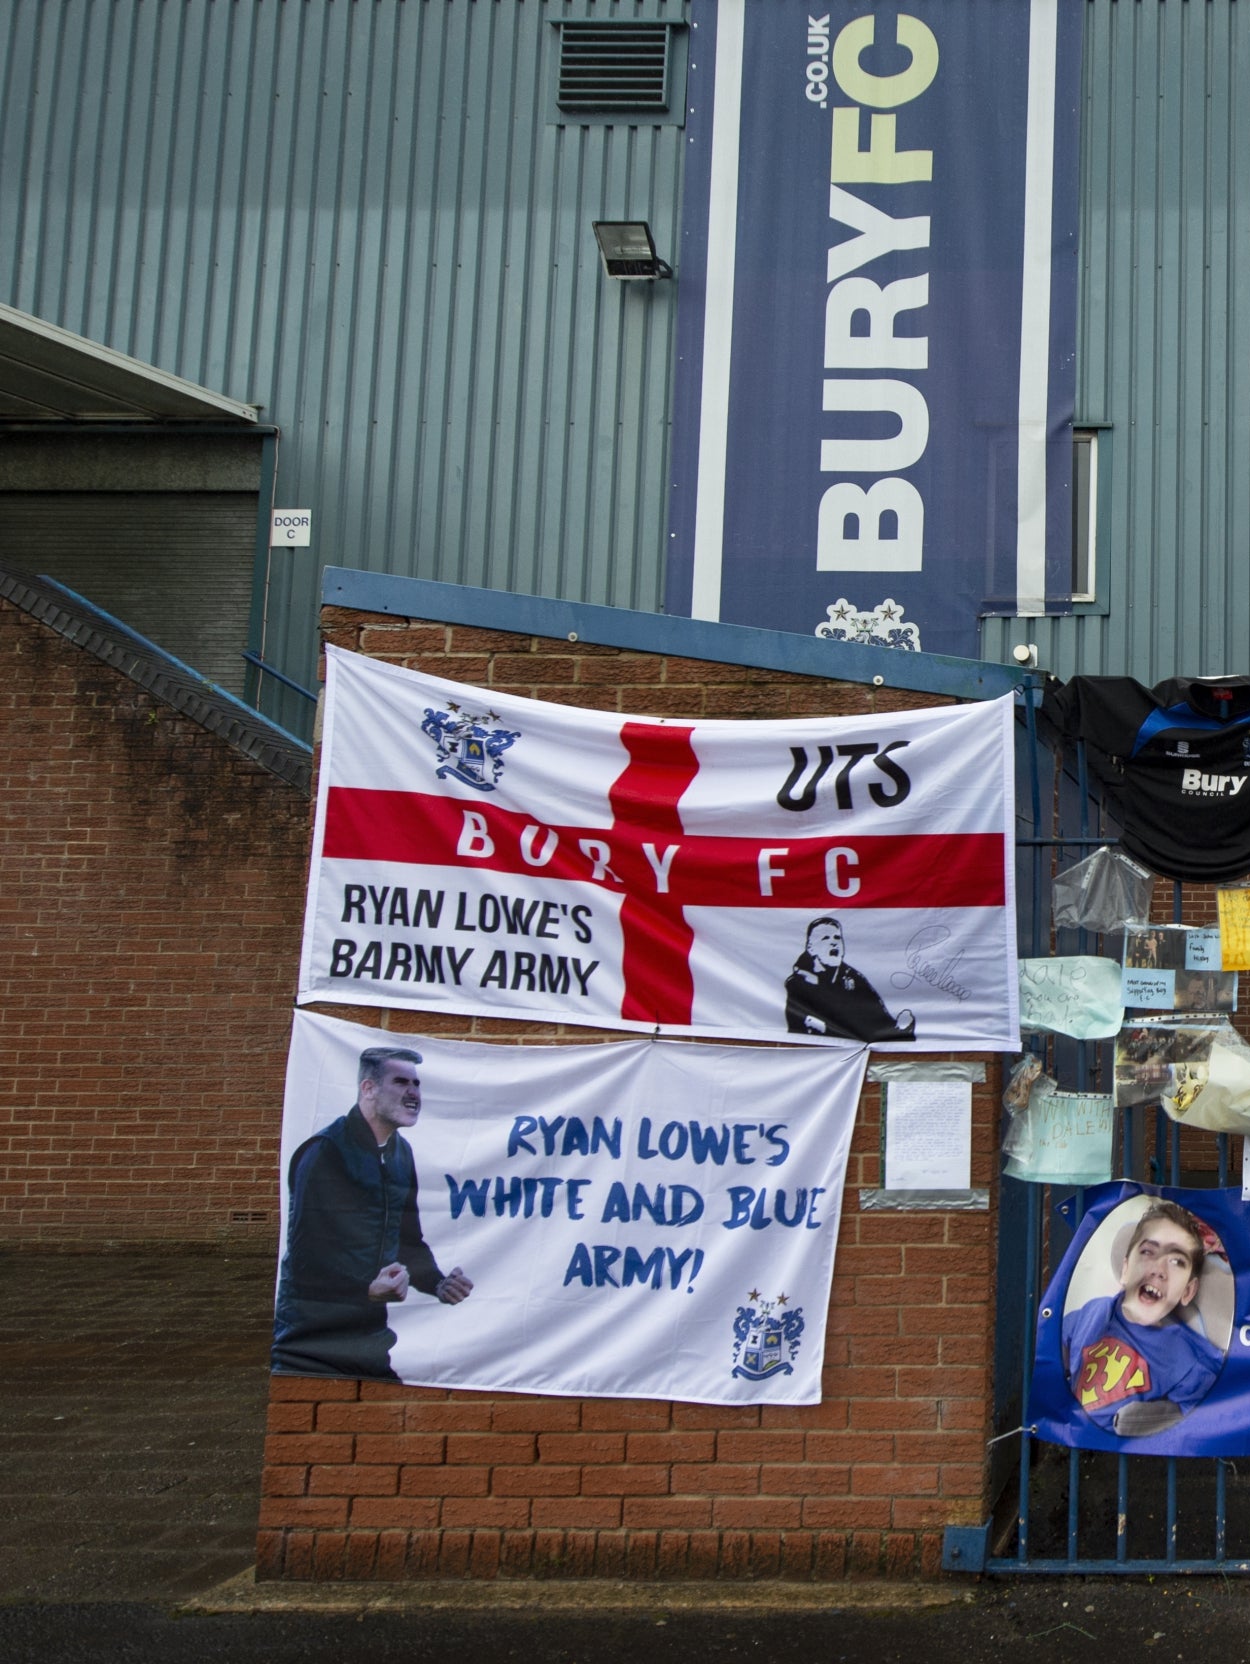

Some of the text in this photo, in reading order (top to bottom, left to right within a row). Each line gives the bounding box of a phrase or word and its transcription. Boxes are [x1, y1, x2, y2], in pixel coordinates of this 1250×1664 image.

[805, 14, 831, 109] .CO.UK
[274, 517, 309, 527] DOOR
[286, 529, 296, 539] C
[776, 741, 911, 813] UTS
[1181, 768, 1248, 796] Bury
[457, 809, 862, 898] BURY FC
[341, 884, 594, 944] RYAN LOWE'S
[329, 938, 600, 997] BARMY ARMY
[506, 1115, 791, 1167] RYAN LOWE'S
[445, 1174, 826, 1231] WHITE AND BLUE
[562, 1242, 705, 1294] ARMY!
